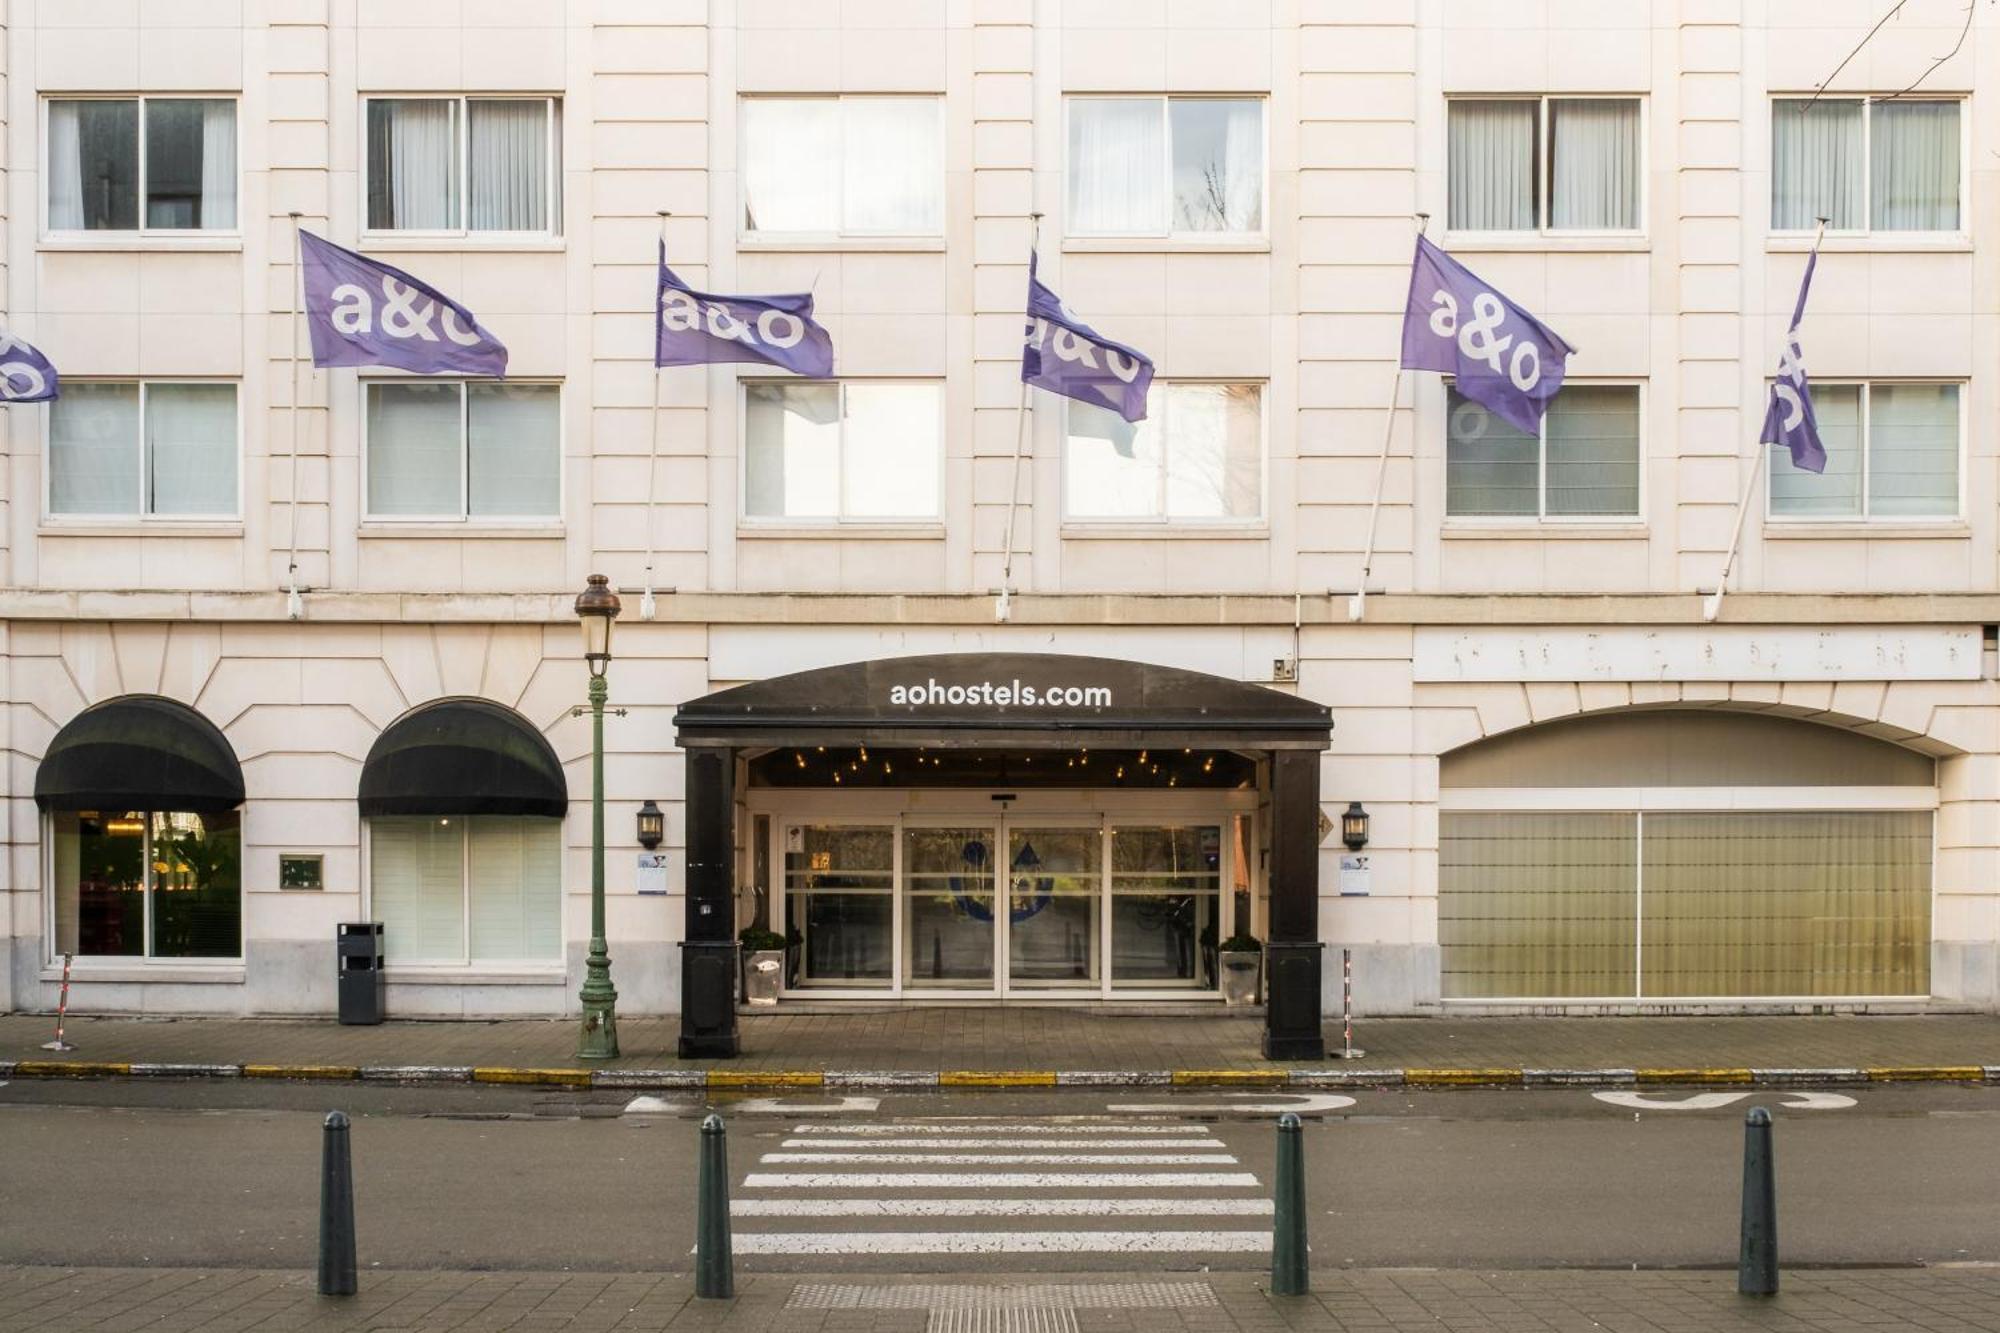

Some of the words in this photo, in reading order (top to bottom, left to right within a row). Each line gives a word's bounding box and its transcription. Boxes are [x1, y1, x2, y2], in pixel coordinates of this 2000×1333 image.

[661, 287, 804, 349] a&o
[1429, 289, 1540, 392] a&o
[890, 678, 1112, 707] aohostels.com
